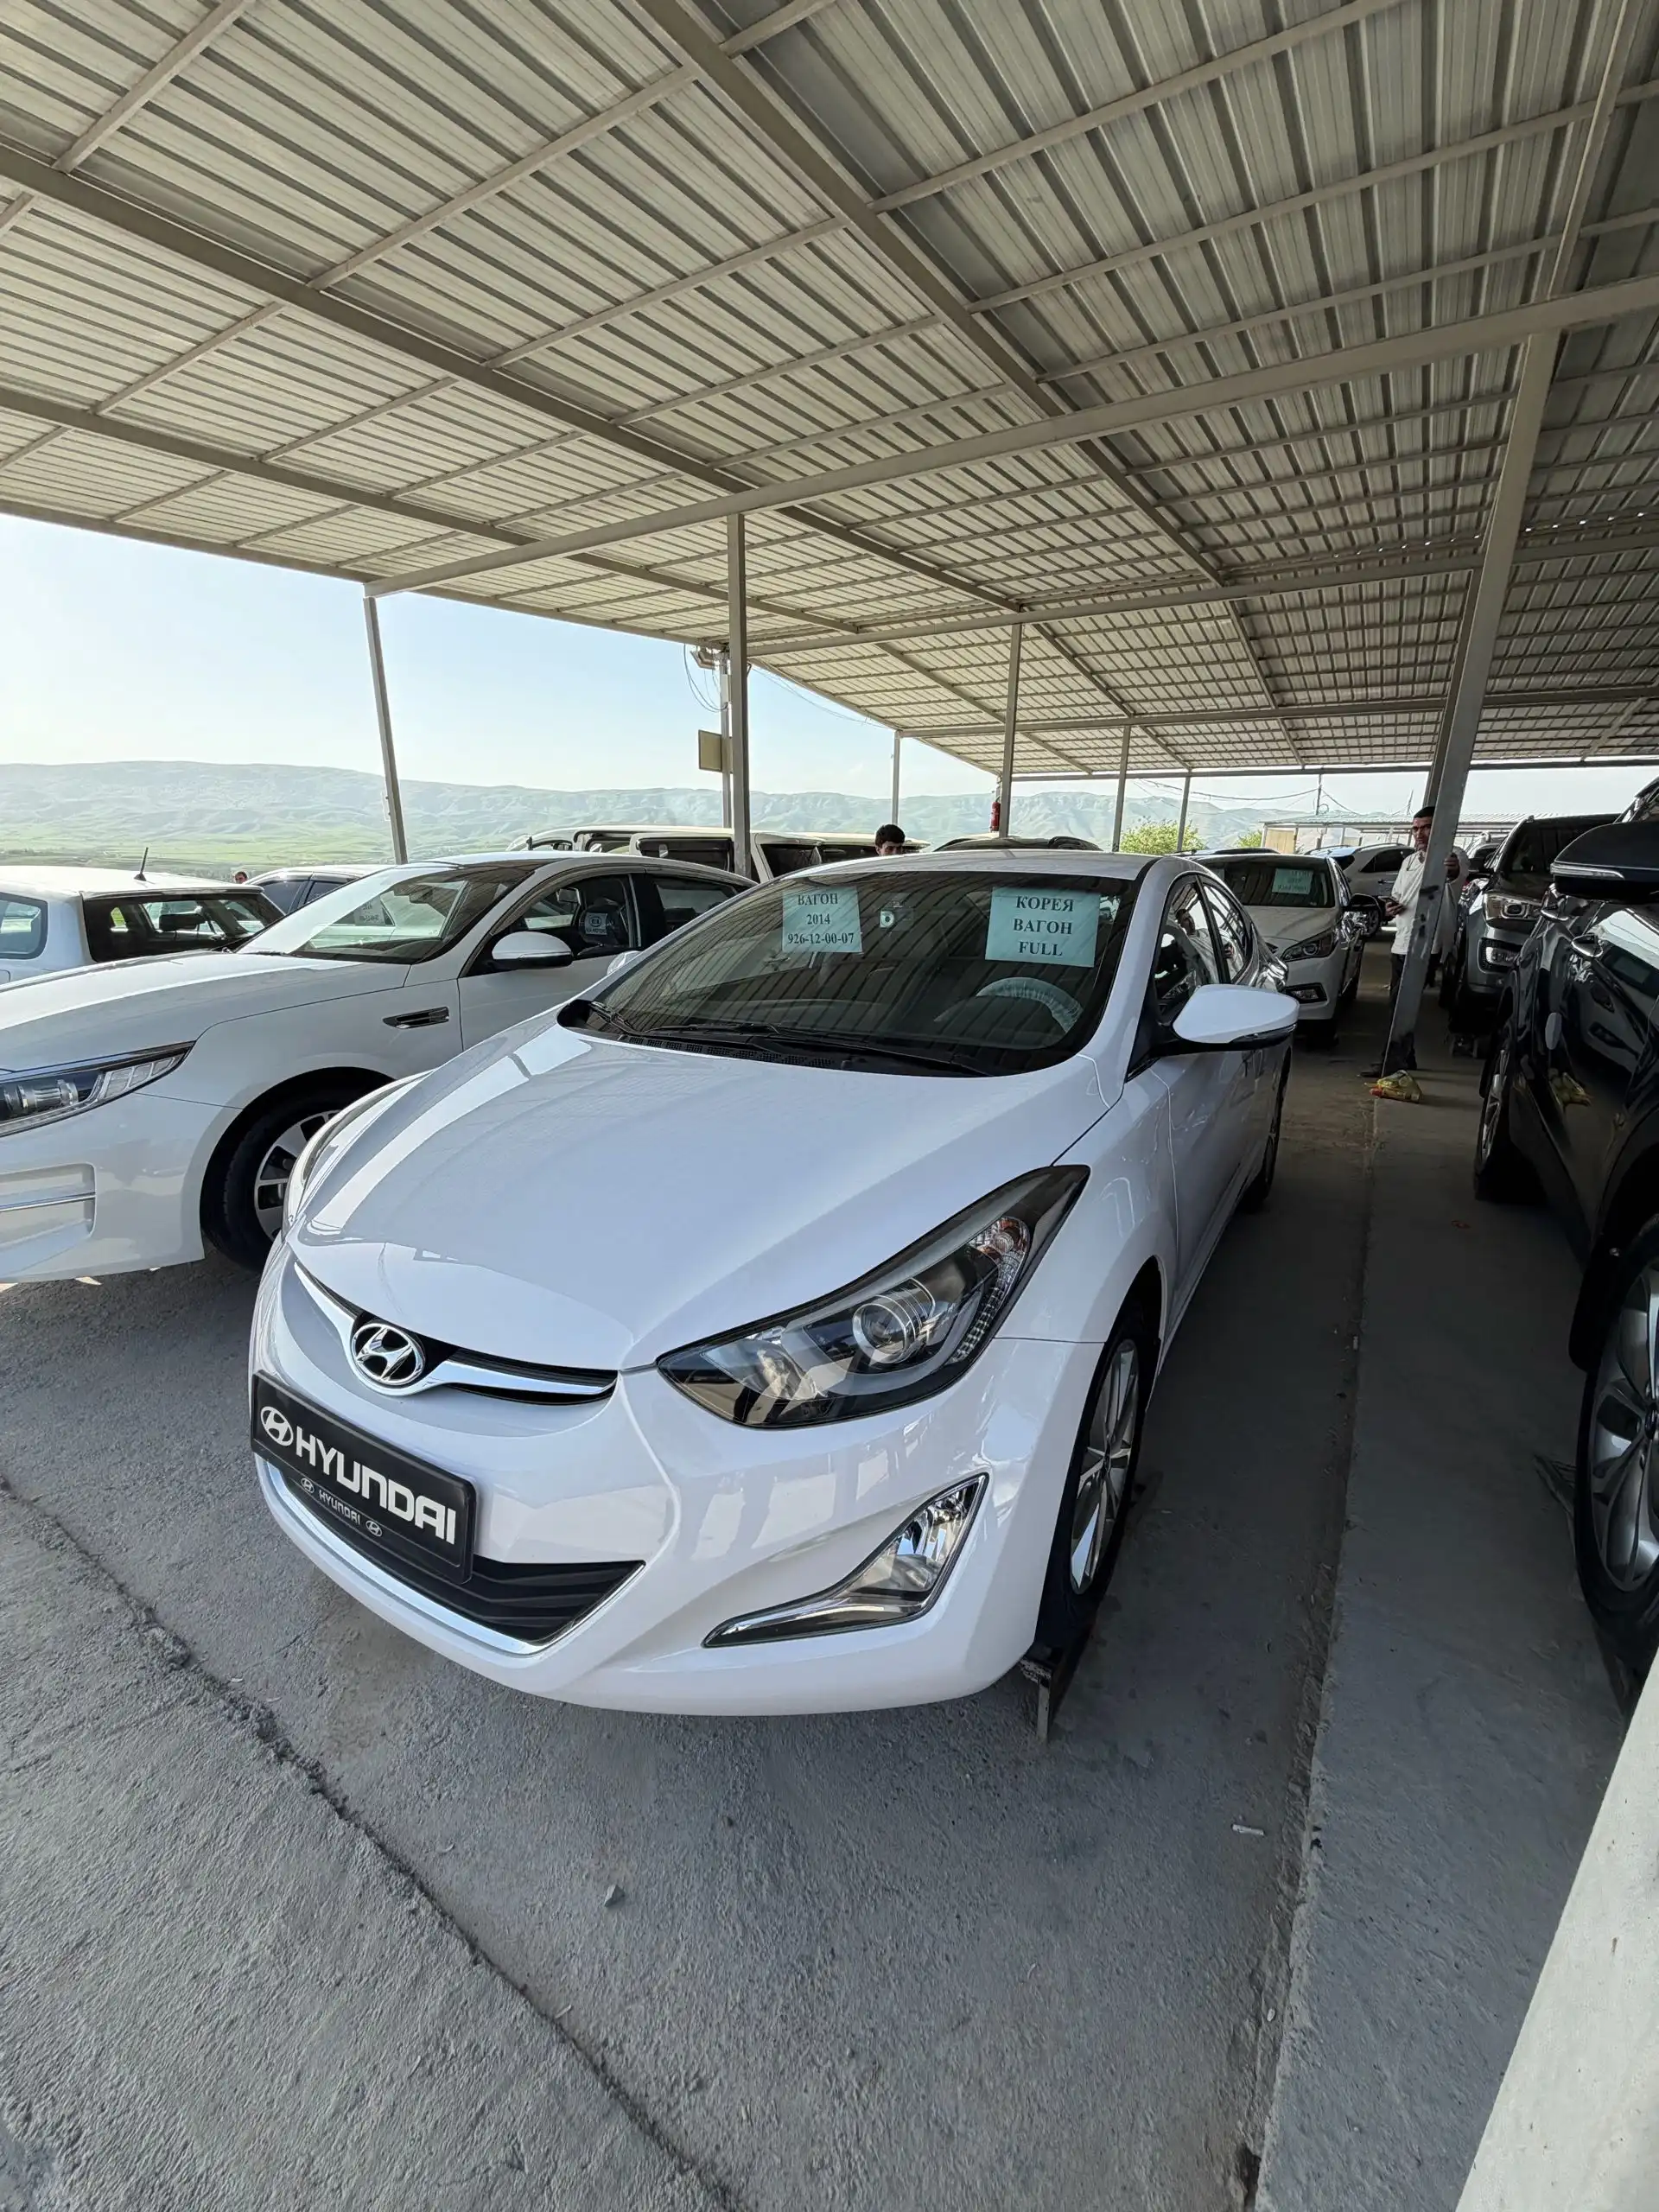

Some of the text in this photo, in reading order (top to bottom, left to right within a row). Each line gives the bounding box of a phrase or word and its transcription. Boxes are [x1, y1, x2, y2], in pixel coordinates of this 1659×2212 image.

[798, 893, 838, 906] ВАГОН
[1016, 895, 1075, 912] КОРЕЯ
[807, 914, 830, 925] 2014
[1014, 918, 1072, 935] ВАГОН
[787, 933, 855, 944] 926-12-00-07
[1019, 941, 1063, 957] FULL
[296, 1426, 456, 1545] HYUNDAI
[319, 1490, 361, 1523] HYUNDAI
